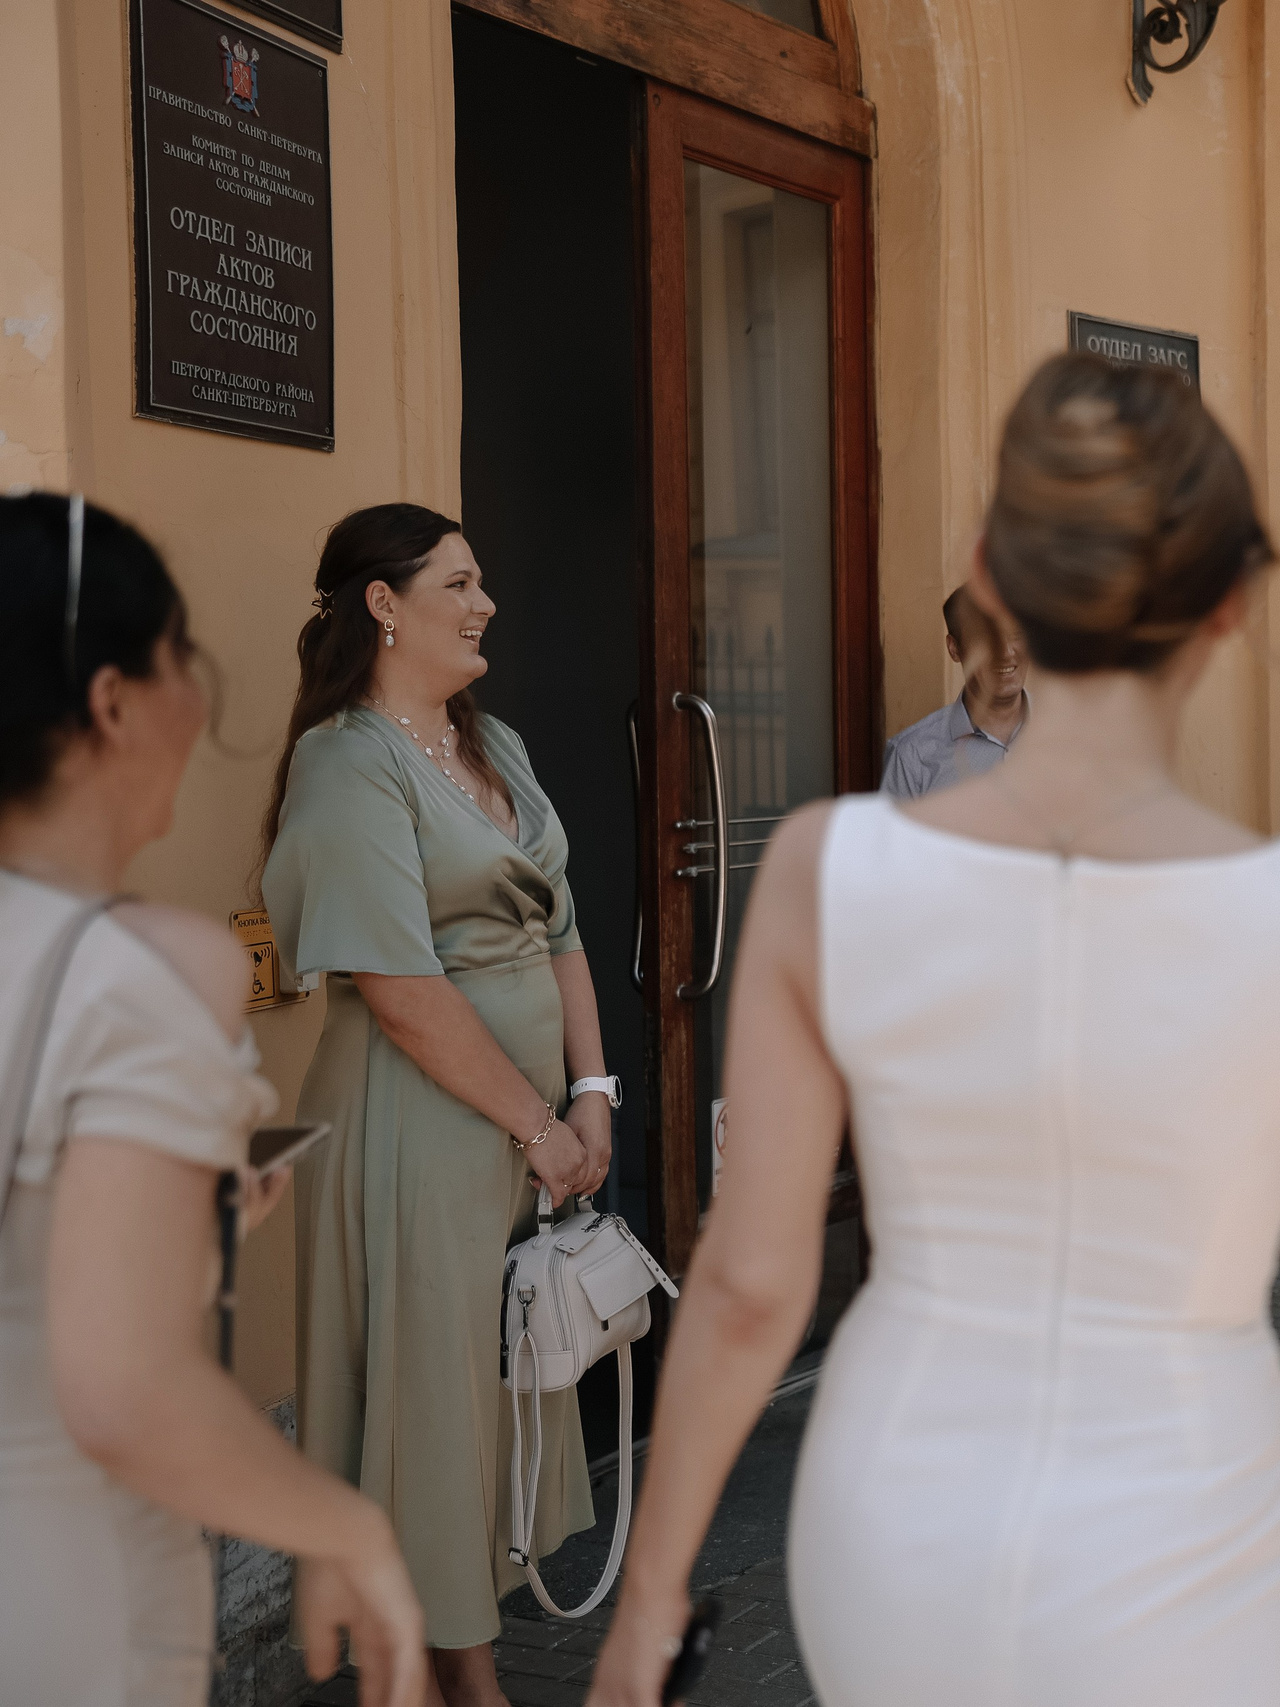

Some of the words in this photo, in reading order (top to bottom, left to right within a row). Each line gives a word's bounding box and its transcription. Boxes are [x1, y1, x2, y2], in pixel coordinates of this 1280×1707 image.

[148, 85, 231, 127] ПРАВИТЕЛЬСТВО
[238, 121, 323, 164] САНКТ-ПЕТЕРБУРГА
[163, 142, 204, 166] ЗАПИСИ
[208, 158, 239, 179] АКТОВ
[243, 171, 315, 206] ГРАЖДАНСКОГО
[191, 135, 237, 161] КОМИТЕТ
[241, 153, 254, 167] ПО
[259, 160, 291, 181] ДЕЛАМ
[216, 178, 272, 207] СОСТОЯНИЯ
[170, 206, 235, 247] ОТДЕЛ
[245, 230, 312, 271] ЗАПИСИ
[216, 253, 275, 289] АКТОВ
[166, 269, 317, 331] ГРАЖДАНСКОГО
[190, 310, 298, 357] СОСТОЯНИЯ
[1088, 335, 1142, 361] ОТДЕЛ
[1148, 346, 1188, 370] ЗАГС
[171, 360, 270, 393] ПЕТРОГРАДСКОГО
[275, 382, 315, 403] РАЙОНА
[192, 384, 297, 418] САНКТ-ПЕТЕРБУРГА
[237, 918, 259, 928] КНОПКА
